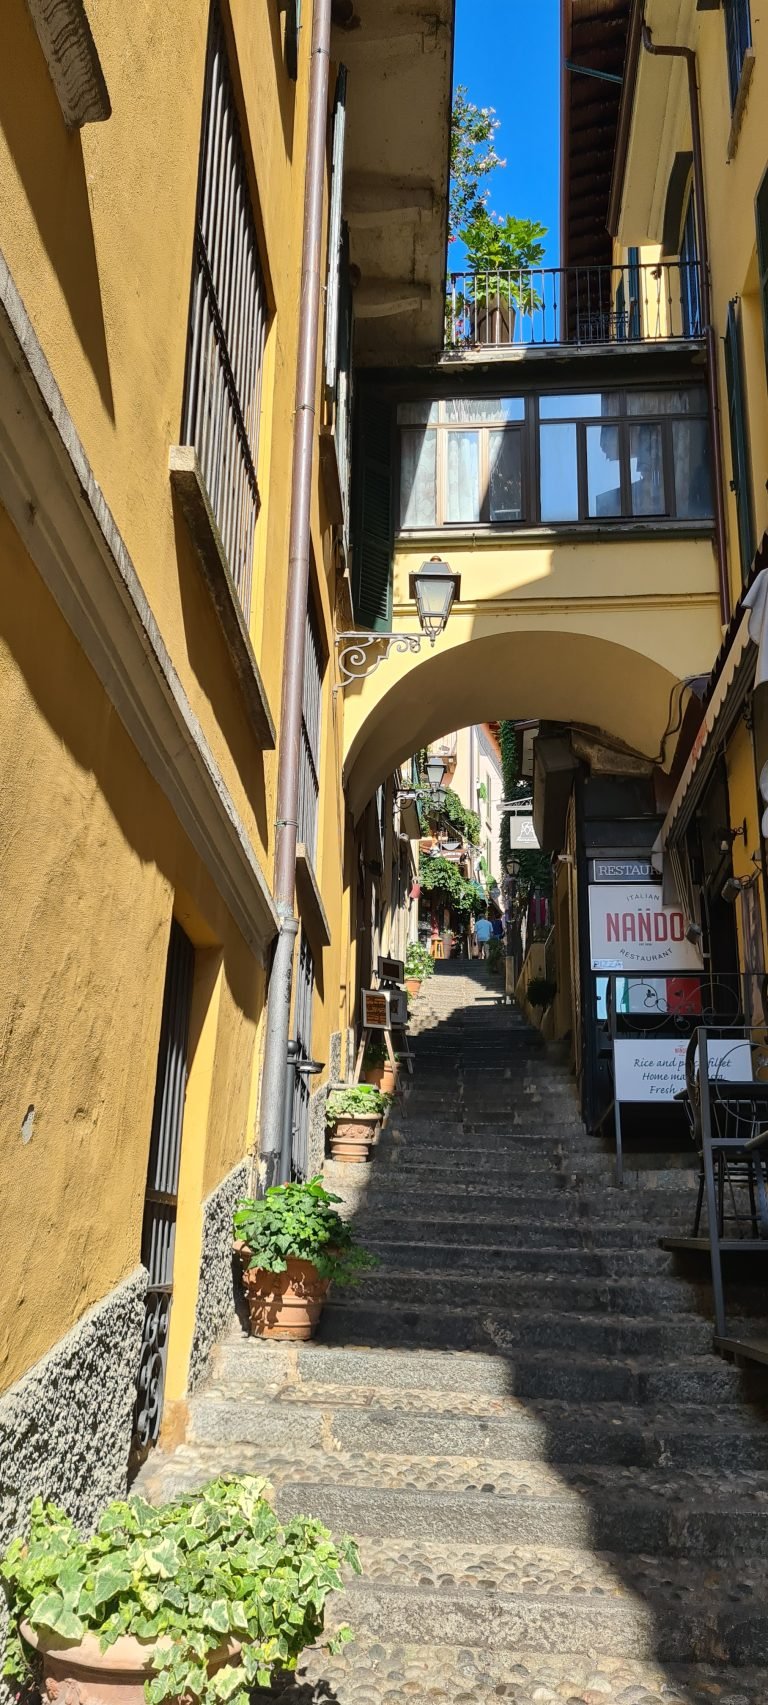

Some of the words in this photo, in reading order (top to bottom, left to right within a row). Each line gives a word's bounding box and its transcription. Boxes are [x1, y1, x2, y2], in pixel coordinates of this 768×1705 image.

[626, 893, 660, 902] ITALIAN
[619, 947, 673, 962] RESTAURANT
[633, 1058, 654, 1068] Rice
[656, 1057, 677, 1067] and
[642, 1072, 669, 1080] Home
[649, 1084, 676, 1094] Fresh
